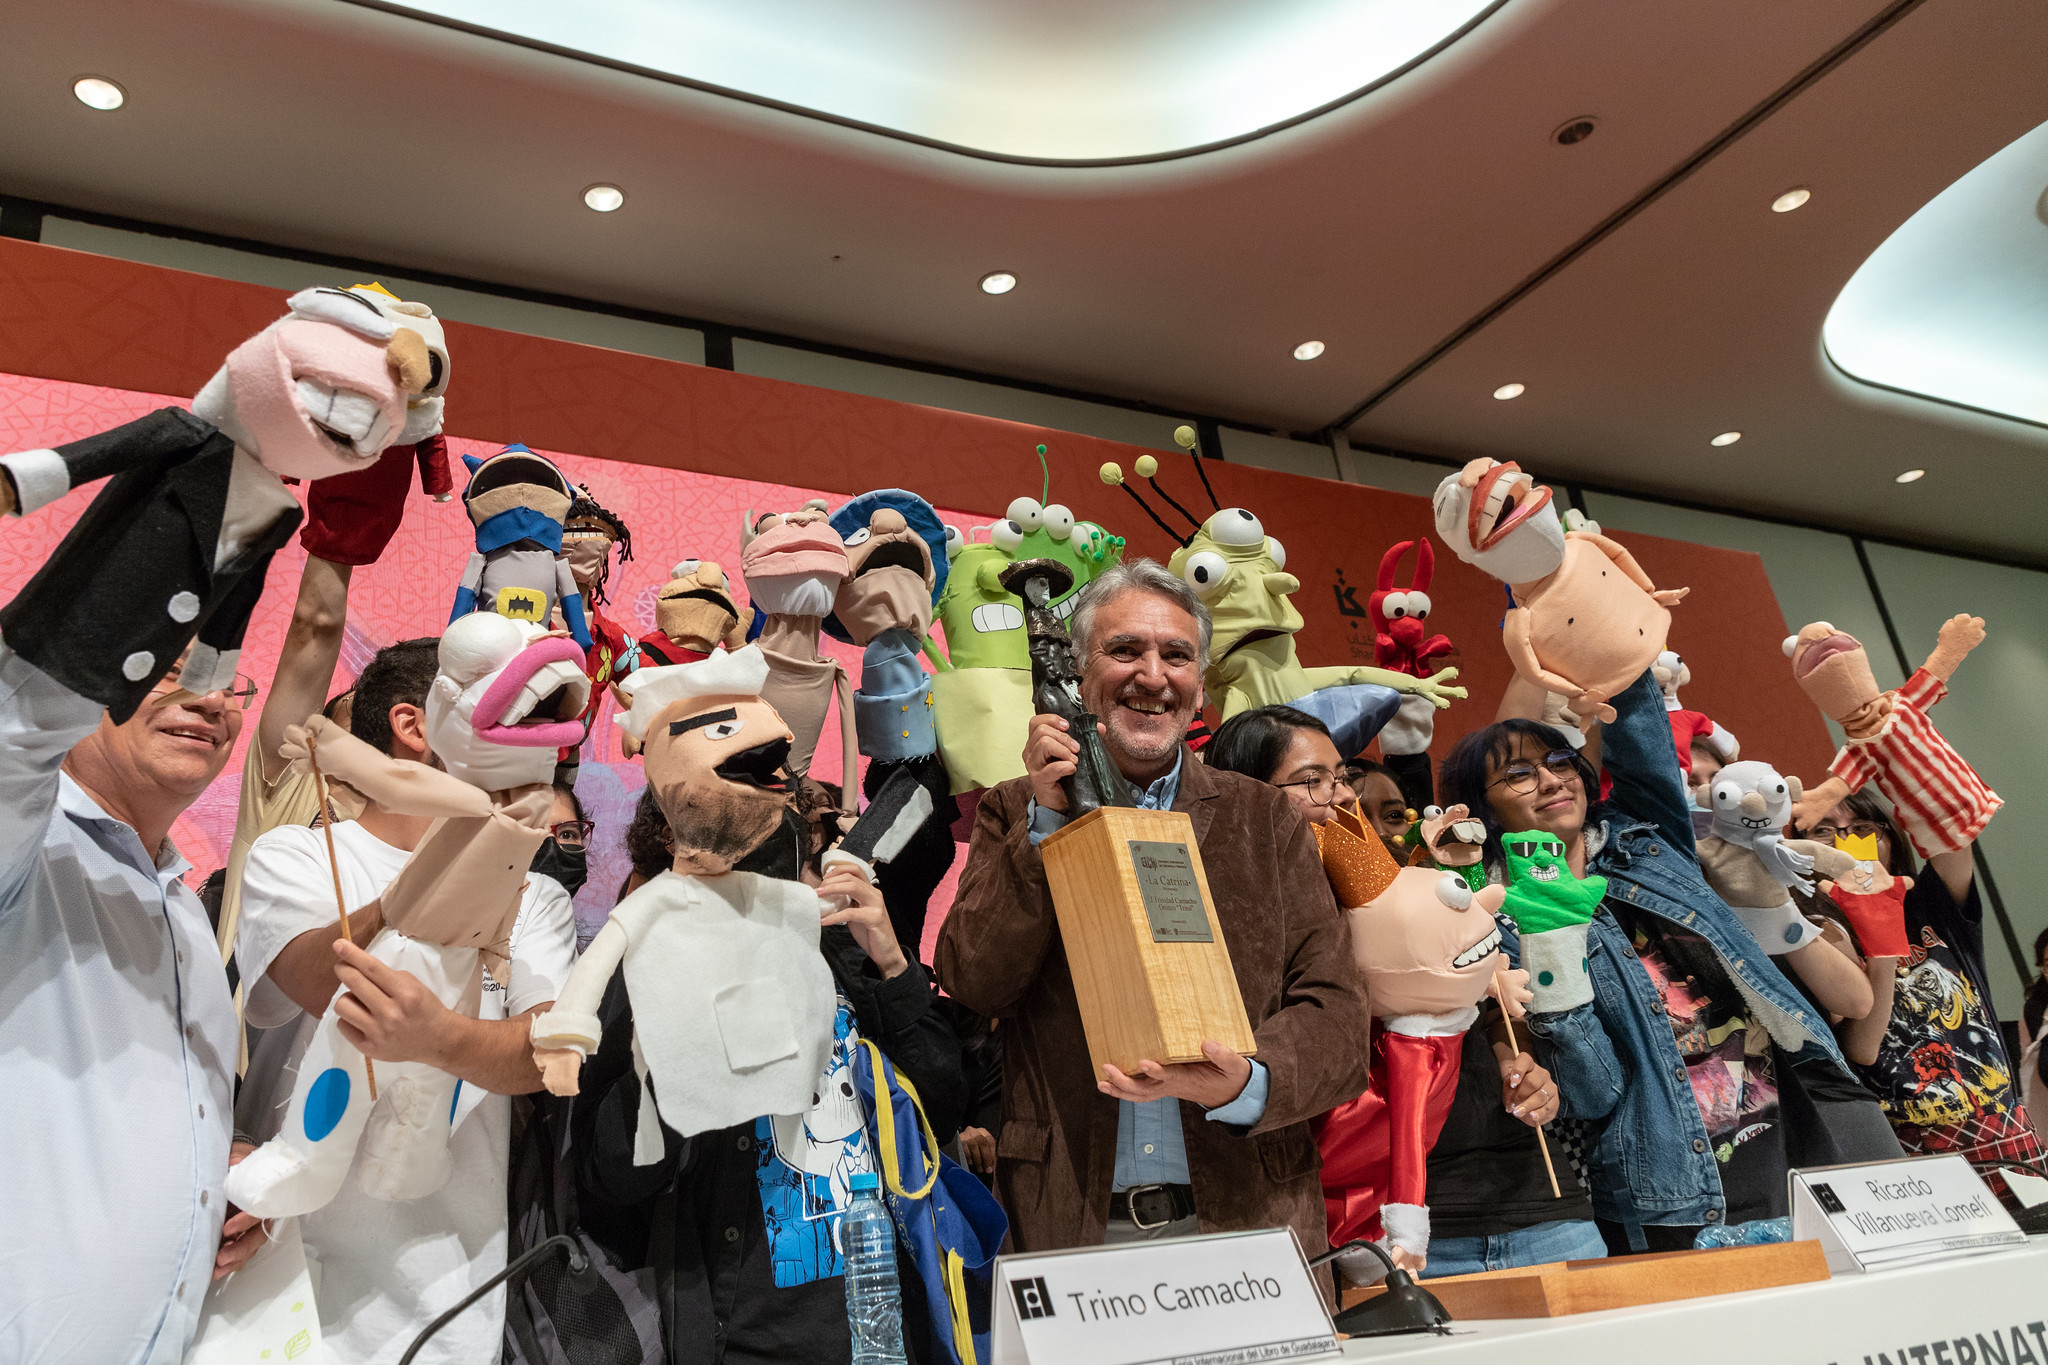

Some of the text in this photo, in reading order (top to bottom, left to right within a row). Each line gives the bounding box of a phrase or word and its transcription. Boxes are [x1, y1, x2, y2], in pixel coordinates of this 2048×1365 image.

[1160, 875, 1190, 887] Catrina
[1866, 1175, 1932, 1202] Ricardo
[1846, 1194, 1991, 1236] Villanueva Lomelí
[1067, 1289, 1146, 1322] Trino
[1154, 1271, 1282, 1312] Camacho
[1260, 1345, 1280, 1358] Libro
[1280, 1343, 1291, 1355] de
[1291, 1338, 1336, 1353] Guadalajara
